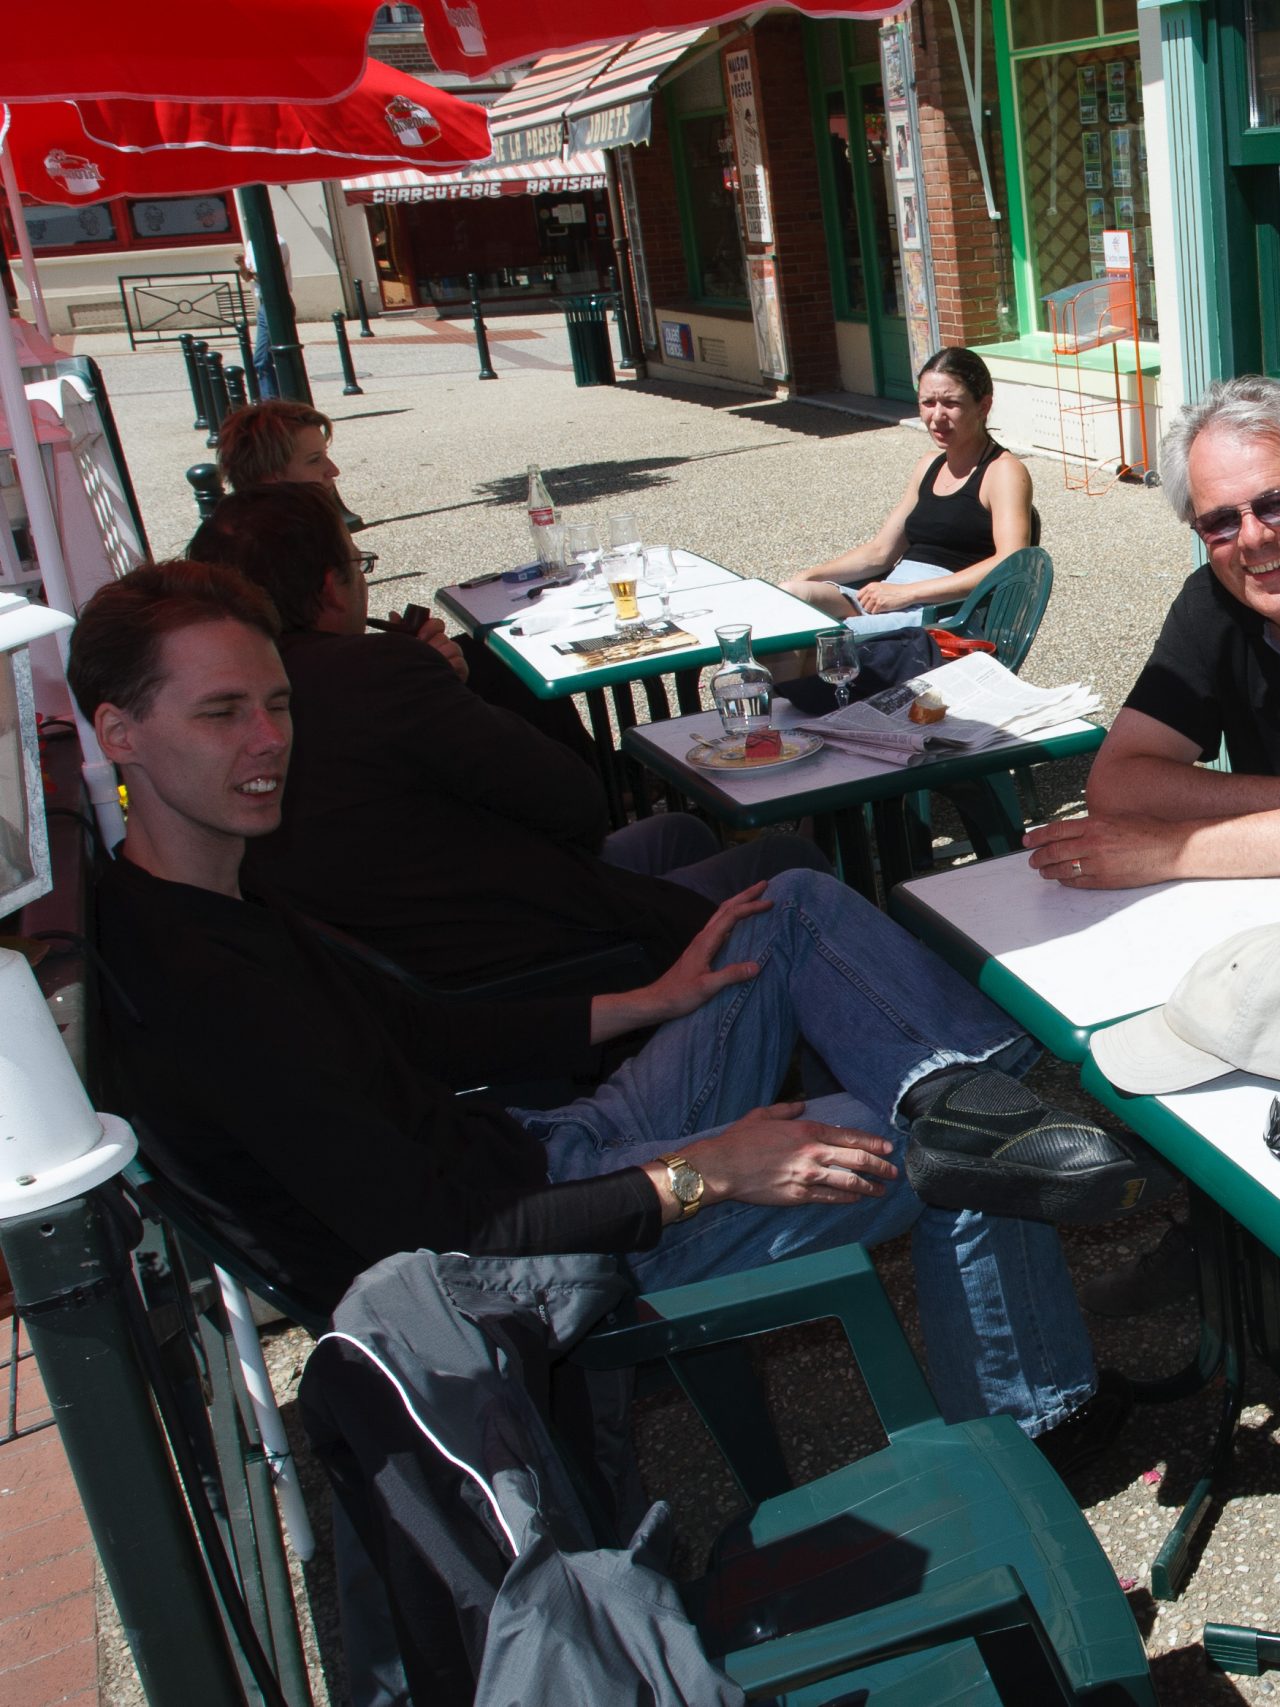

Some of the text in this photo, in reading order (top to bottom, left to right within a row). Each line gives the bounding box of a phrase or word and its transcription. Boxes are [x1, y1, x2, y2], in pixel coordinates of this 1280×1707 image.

[731, 81, 753, 99] PRESSE
[525, 122, 562, 157] PRESSE
[585, 103, 632, 144] JOUETS
[372, 182, 501, 204] CHARCUTERIE
